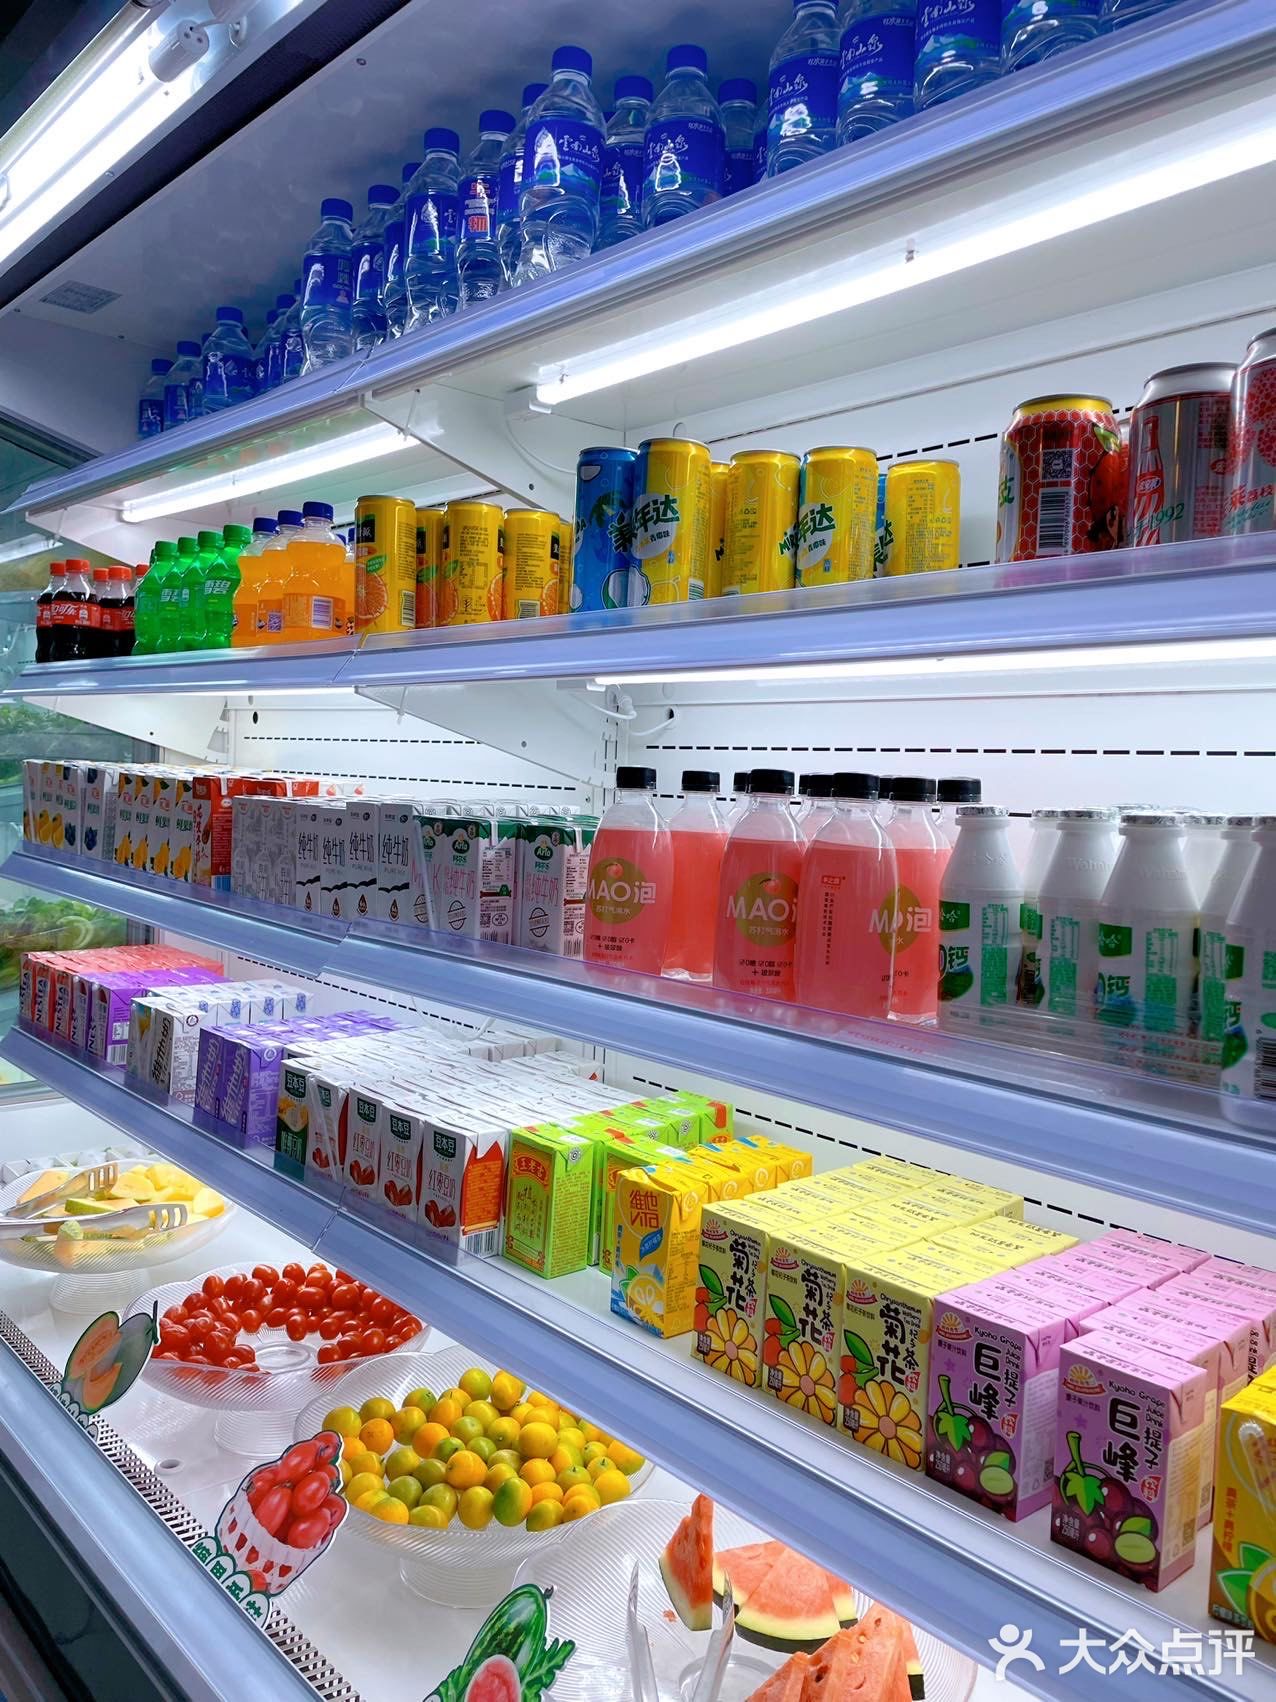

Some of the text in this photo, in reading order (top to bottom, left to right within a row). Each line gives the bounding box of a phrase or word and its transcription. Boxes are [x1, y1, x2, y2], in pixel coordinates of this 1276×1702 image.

[204, 579, 231, 595] 雪碧
[323, 837, 345, 867] 纯牛奶
[349, 831, 375, 863] 纯牛奶
[382, 833, 409, 867] 纯牛奶
[359, 1102, 375, 1118] 豆本豆
[392, 1119, 410, 1136] 豆本豆
[435, 1134, 454, 1153] 豆本豆
[726, 1238, 750, 1312] 菊花
[798, 1268, 823, 1345] 菊花
[876, 1303, 906, 1385] 菊花
[975, 1326, 998, 1341] Kyoho
[970, 1342, 1002, 1421] 巨峰
[1109, 1380, 1136, 1396] Kyoho
[1103, 1397, 1141, 1483] 巨峰
